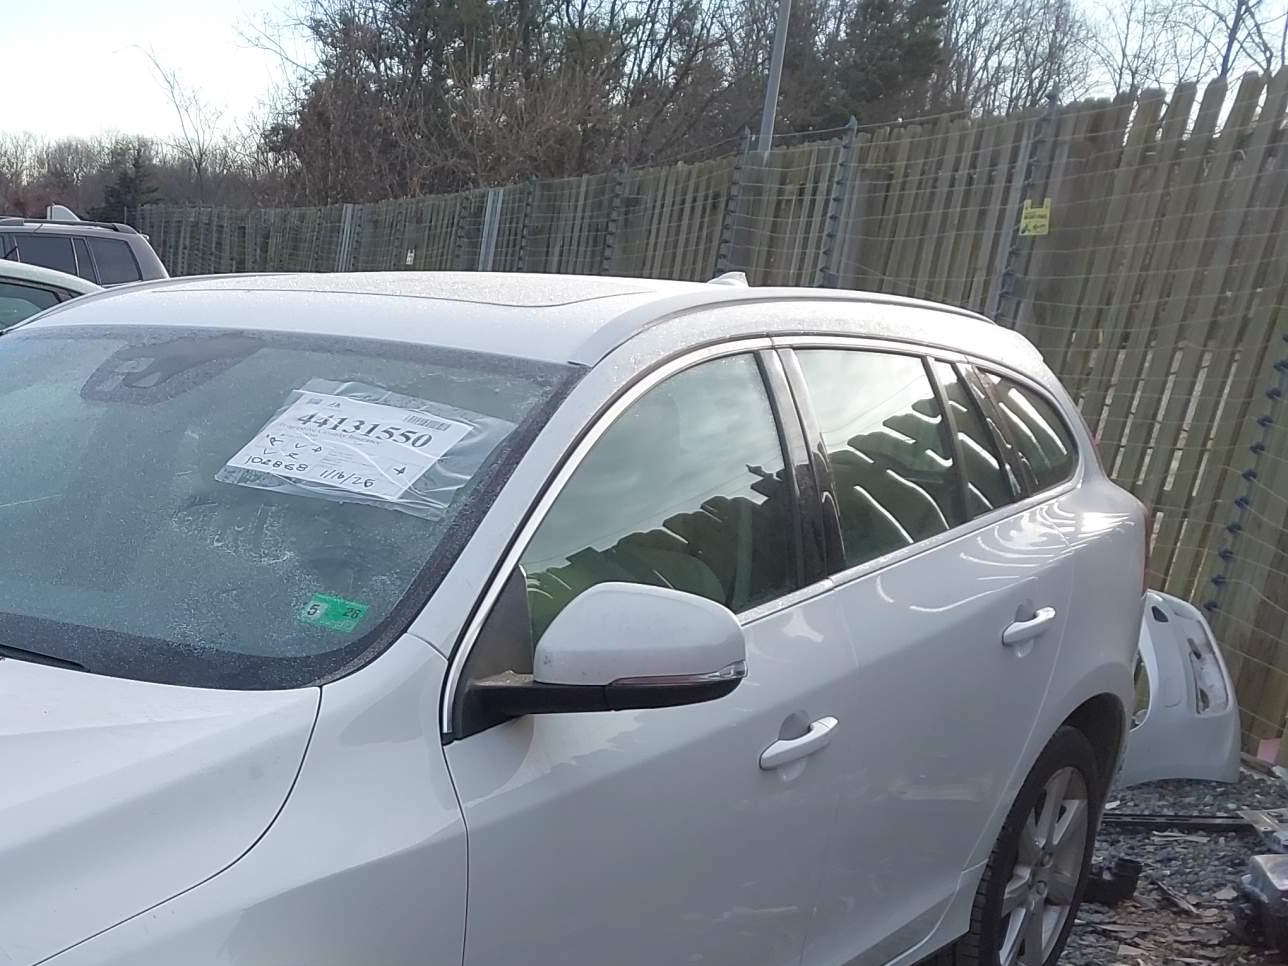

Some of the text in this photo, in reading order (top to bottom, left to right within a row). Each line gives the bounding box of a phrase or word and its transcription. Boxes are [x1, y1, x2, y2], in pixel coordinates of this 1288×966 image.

[297, 411, 433, 448] 44131550
[307, 603, 361, 619] 5 26
